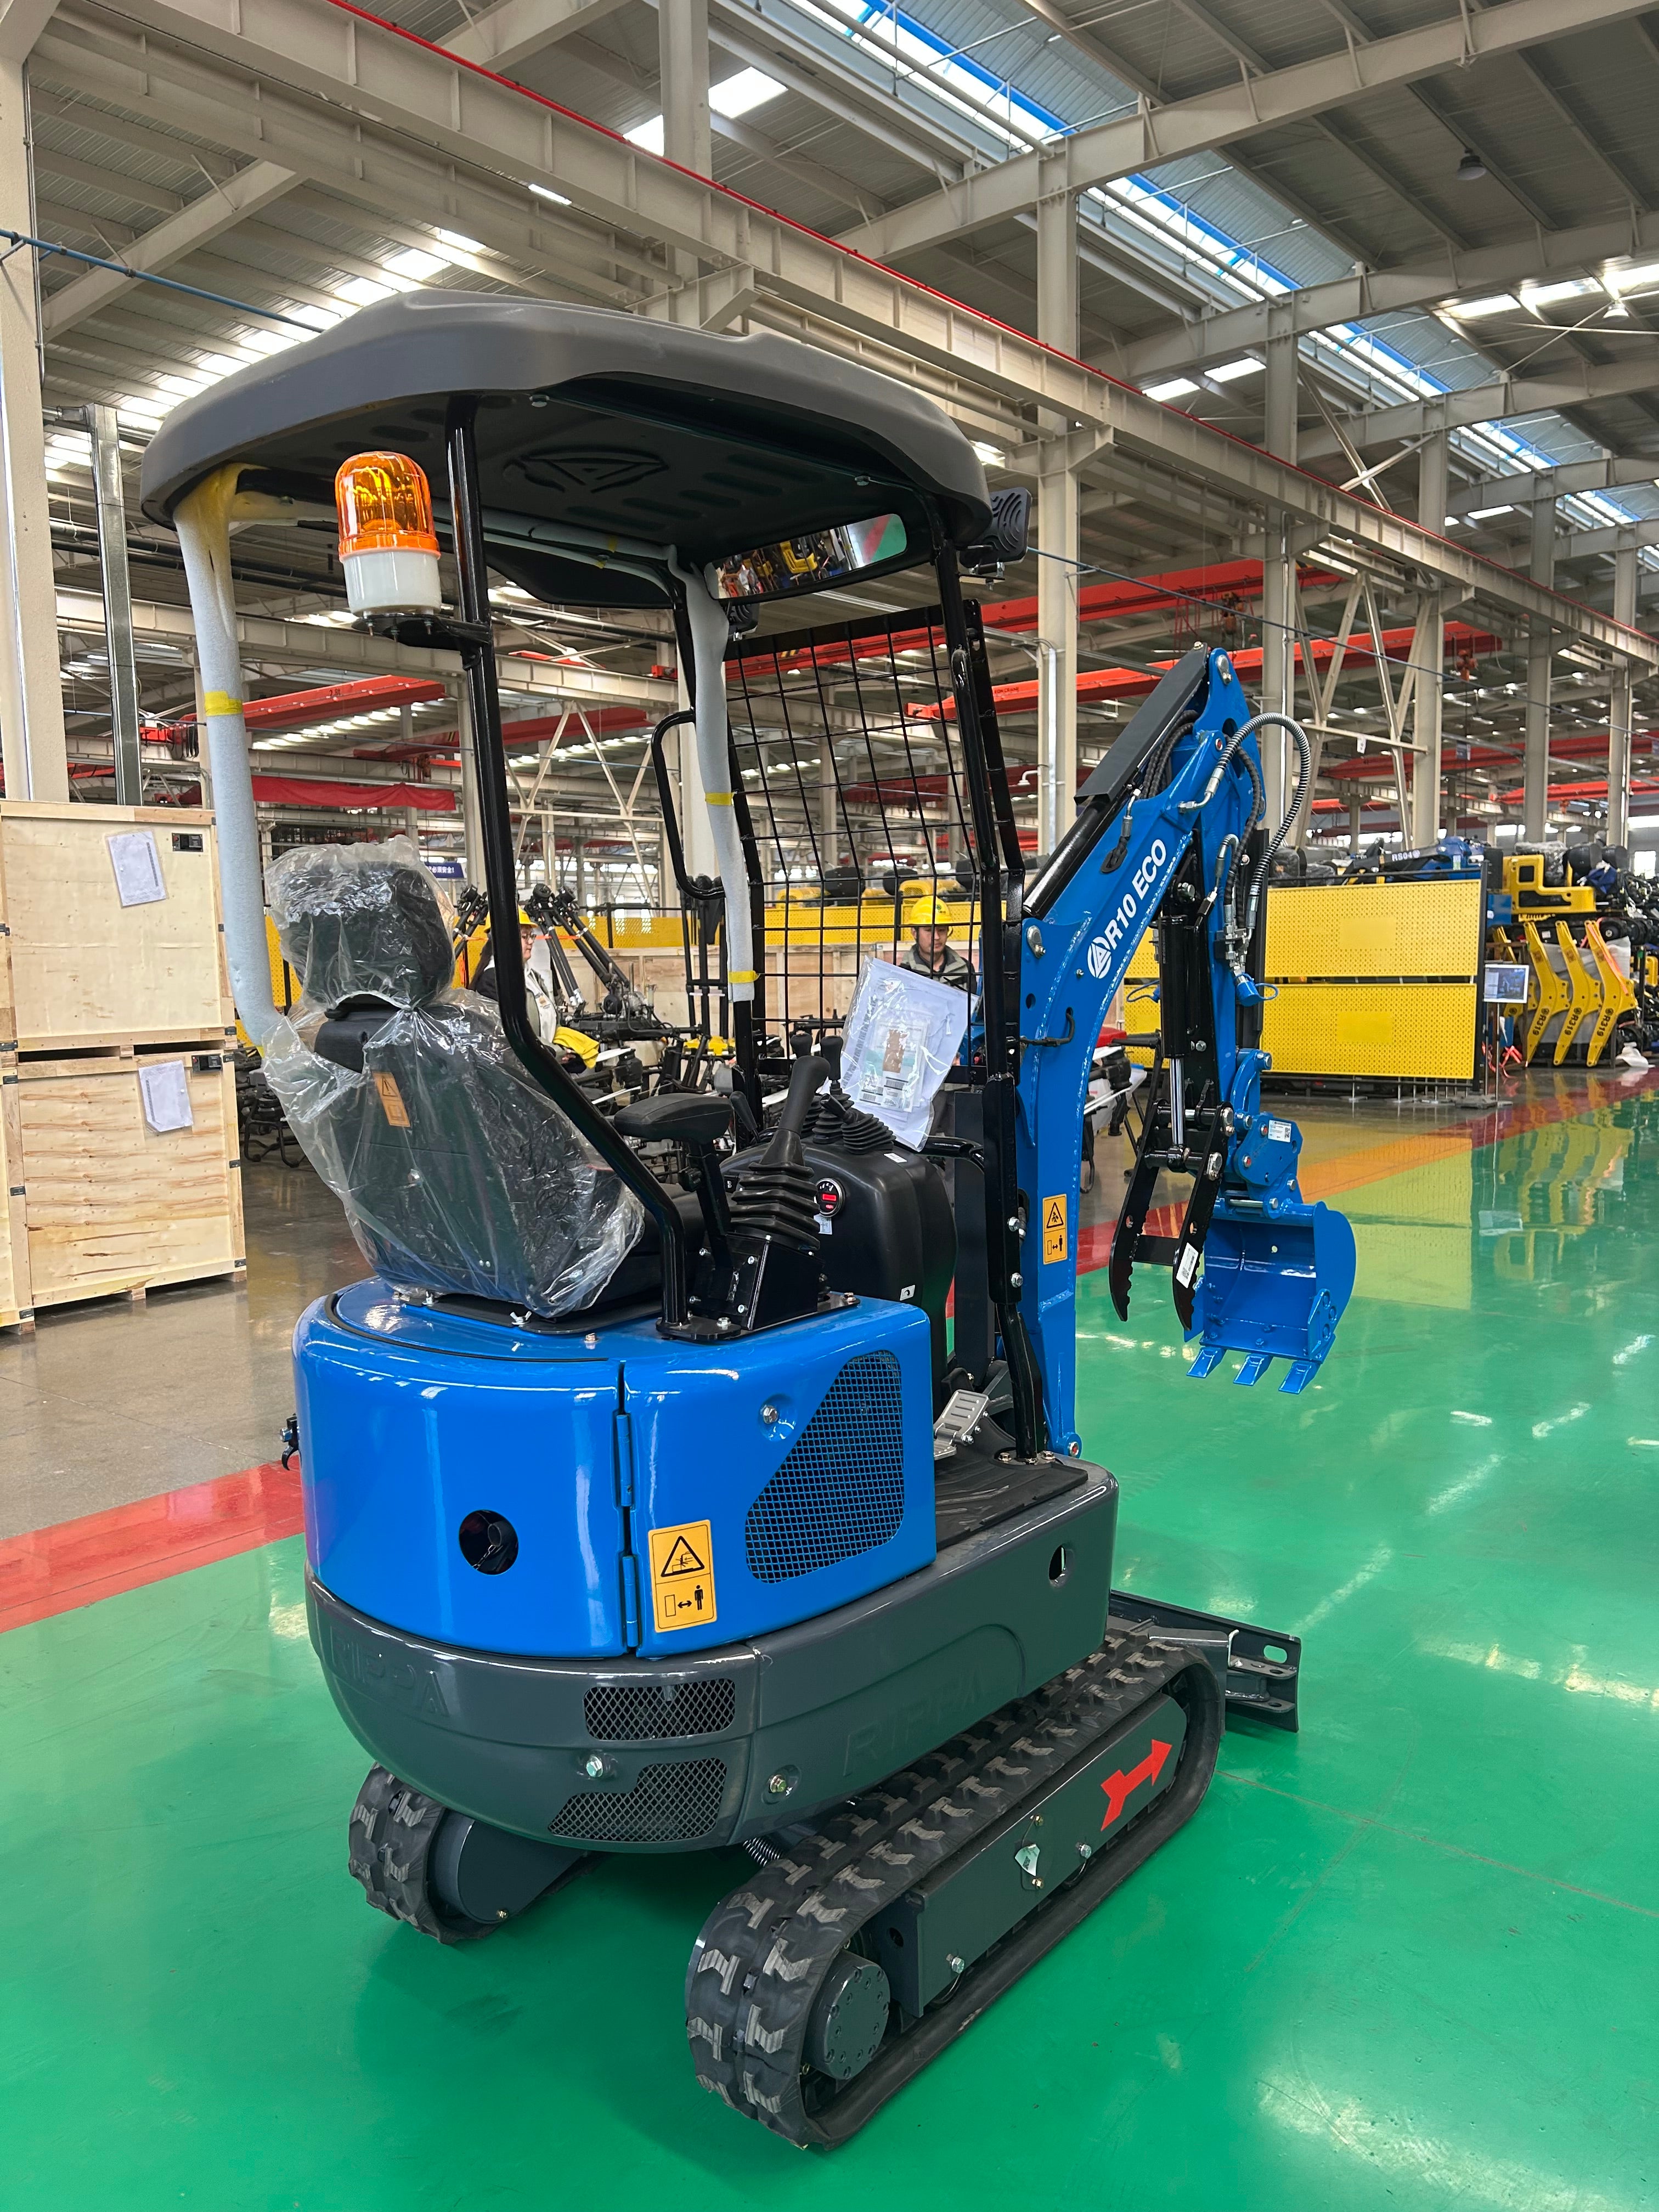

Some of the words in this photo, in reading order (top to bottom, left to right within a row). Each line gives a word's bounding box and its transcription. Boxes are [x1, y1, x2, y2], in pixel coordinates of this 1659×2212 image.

[1104, 894, 1137, 950] R10
[1132, 839, 1166, 900] ECO
[1532, 1014, 1546, 1036] R319
[1564, 1014, 1578, 1036] R319
[1597, 1014, 1611, 1036] R319
